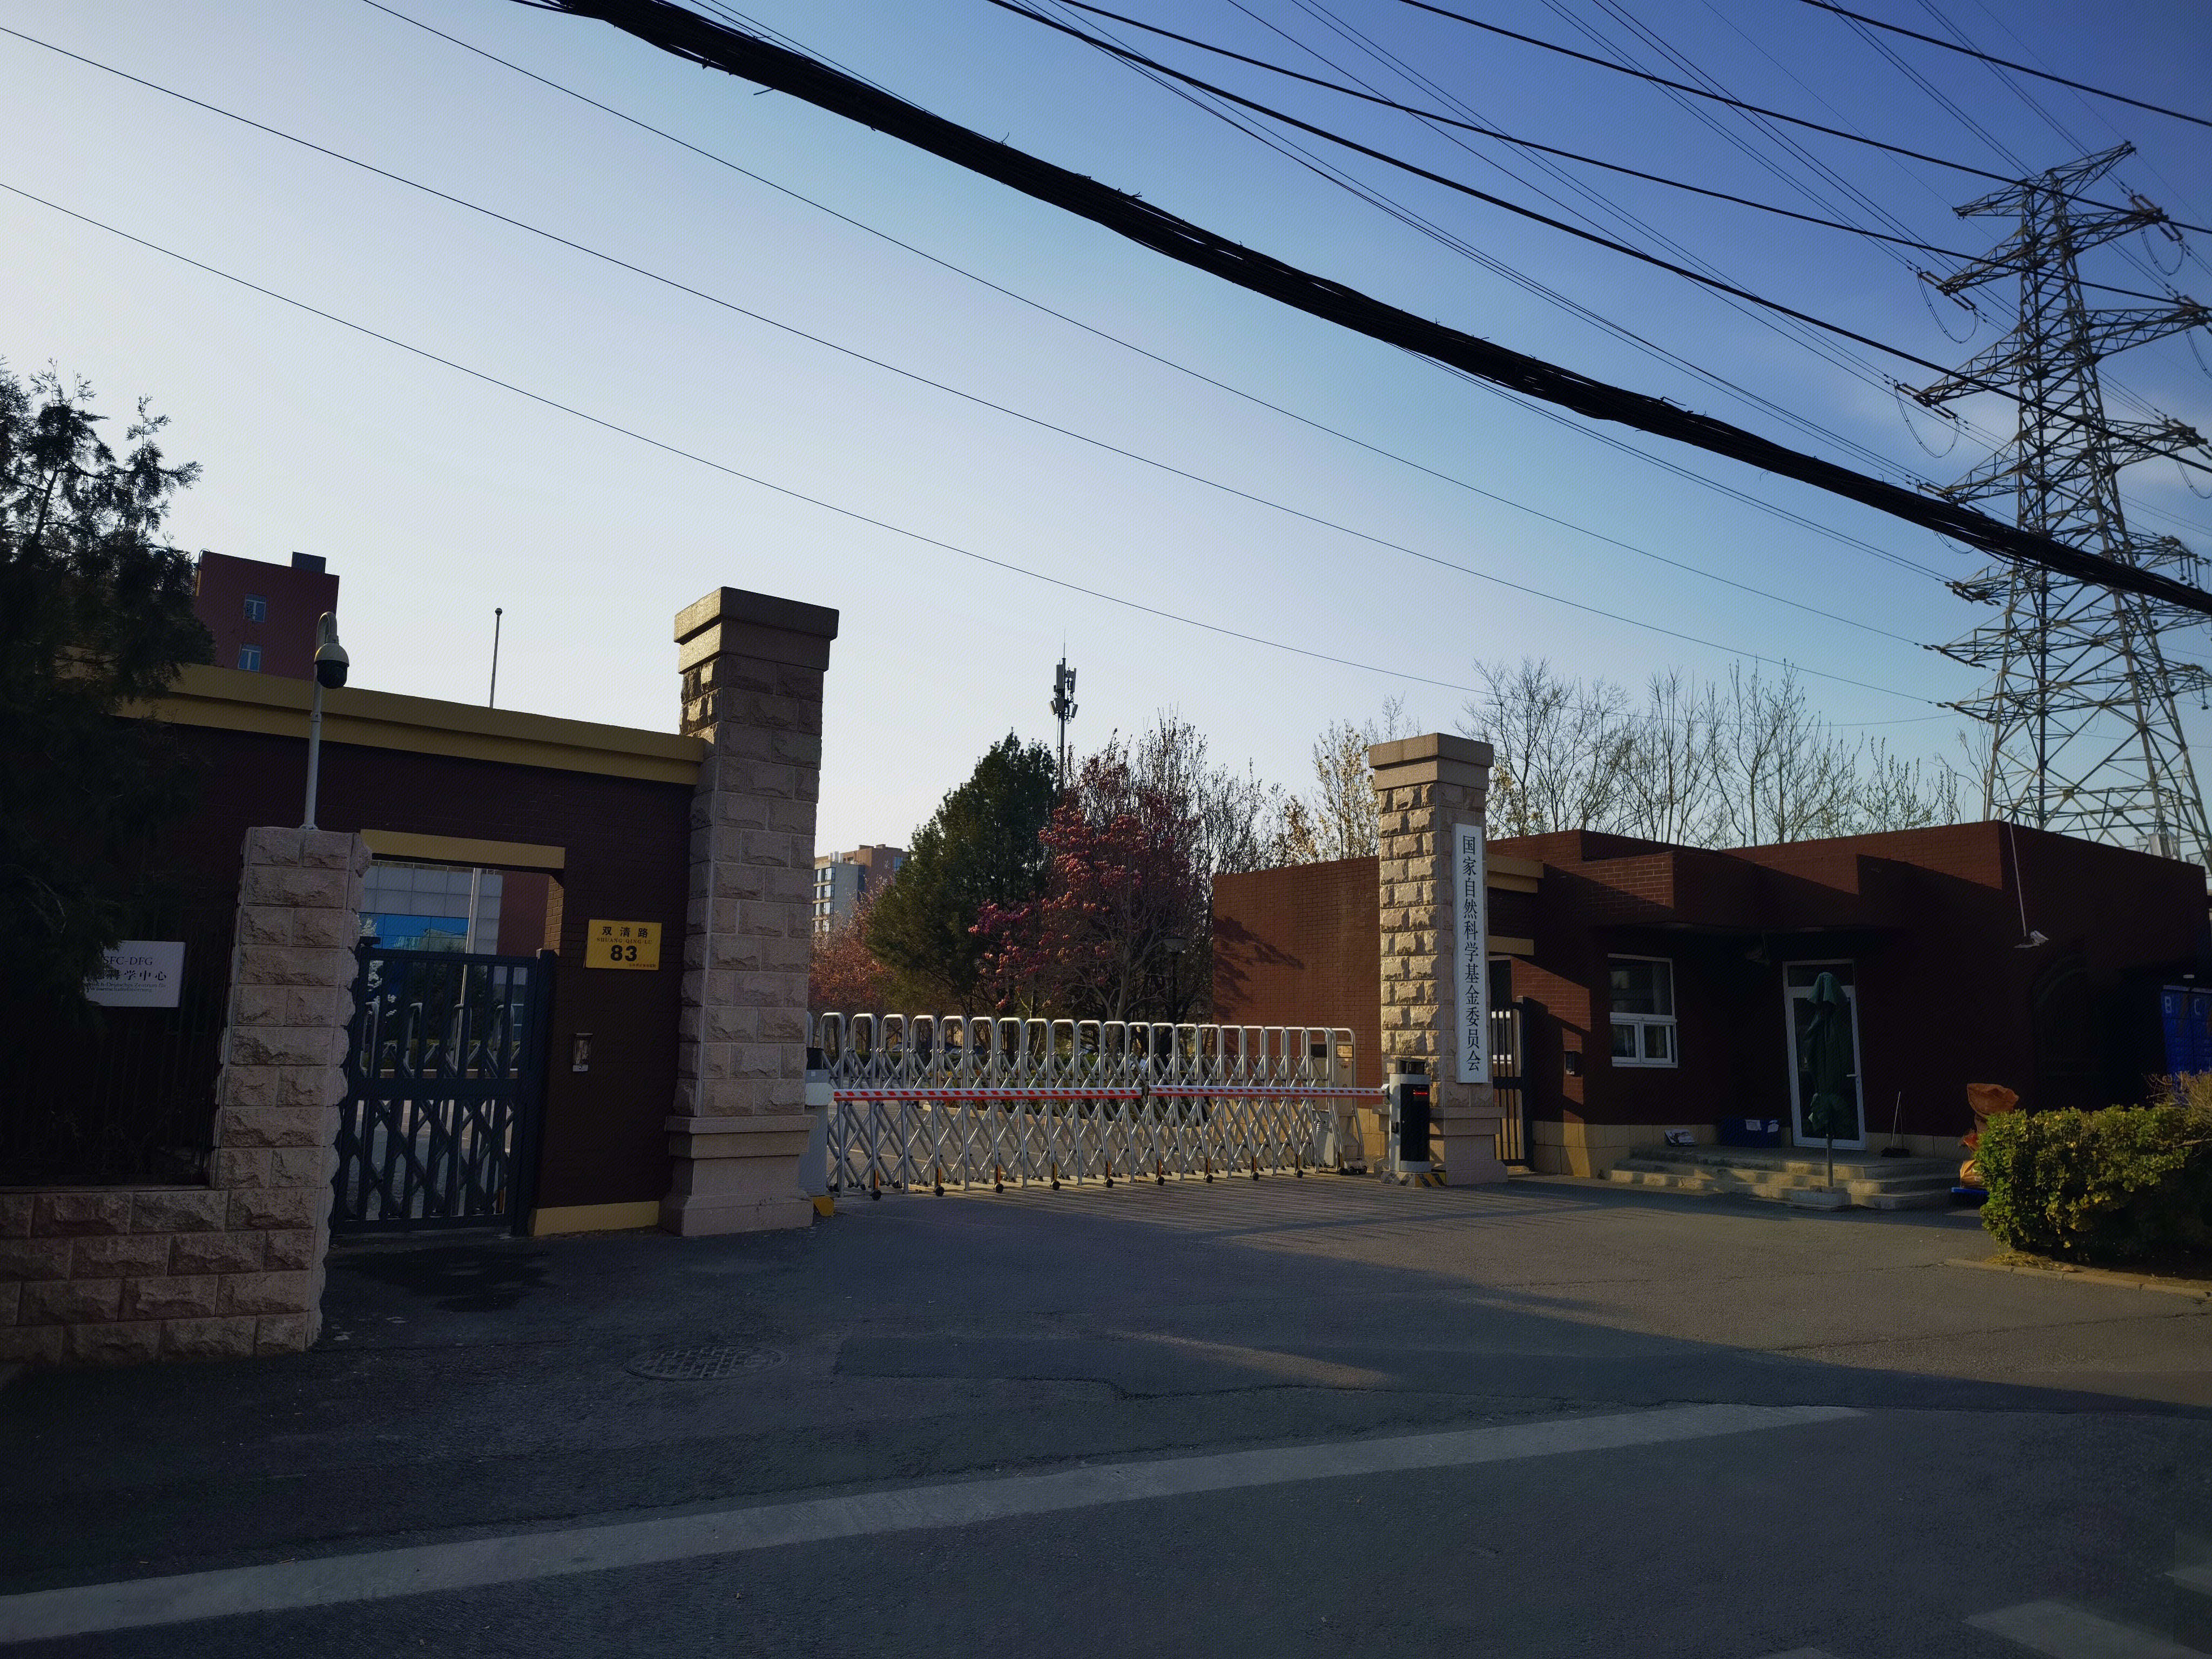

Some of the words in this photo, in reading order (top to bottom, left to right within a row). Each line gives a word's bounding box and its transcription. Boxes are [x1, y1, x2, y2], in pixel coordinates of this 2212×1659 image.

[602, 926, 648, 938] 双清路
[610, 945, 637, 962] 83
[1462, 835, 1482, 1072] 国家自然科学基金委员会
[103, 956, 153, 966] SFC-DFG
[97, 969, 167, 981] 科学中心
